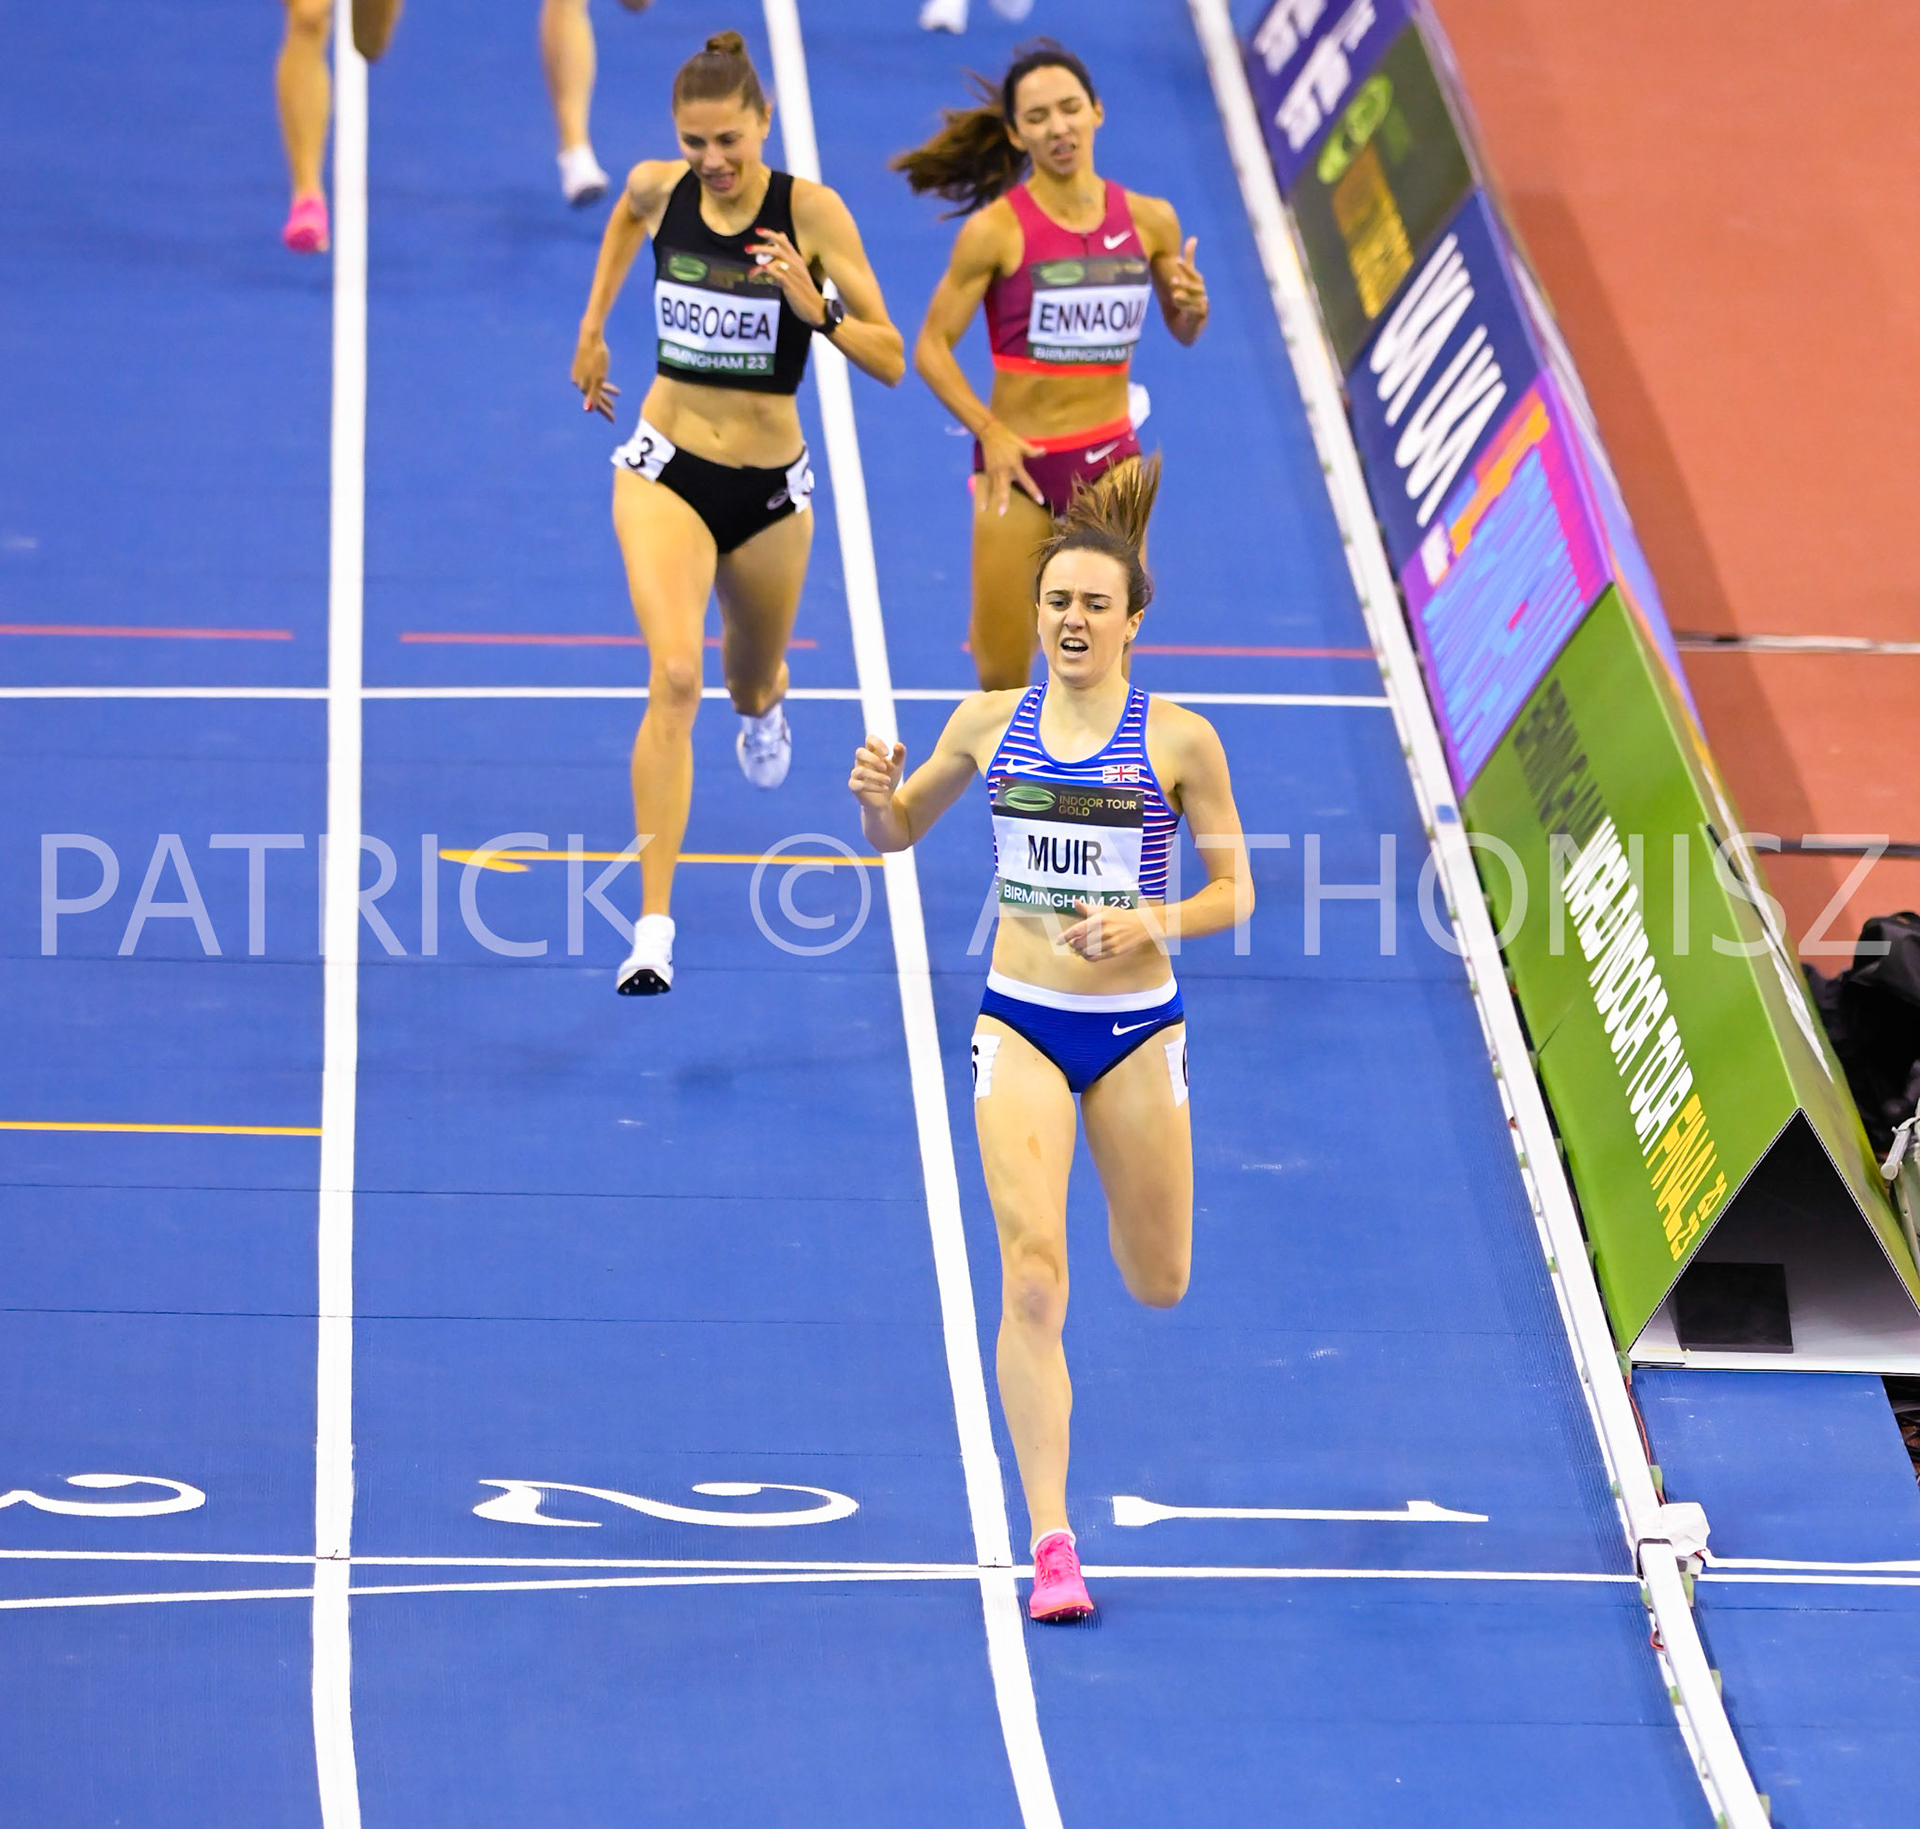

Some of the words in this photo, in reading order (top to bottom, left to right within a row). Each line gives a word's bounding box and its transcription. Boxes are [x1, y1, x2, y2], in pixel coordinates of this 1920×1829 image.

[661, 296, 771, 341] BOBOCEA
[661, 343, 744, 370] BIRMINGHAM
[747, 354, 767, 370] 23
[625, 436, 654, 469] 3
[1058, 805, 1091, 816] GOLD
[1059, 795, 1104, 808] INDOOR
[1106, 798, 1137, 810] TOUR
[1027, 835, 1102, 877] MUIR
[1003, 884, 1105, 909] BIRMINGHAM
[1109, 895, 1131, 909] 23
[1560, 815, 1638, 962] WORLD
[1588, 909, 1668, 1077] INDOOR
[1625, 1014, 1693, 1157] TOUR
[1644, 1092, 1717, 1241] FINAL
[472, 1479, 859, 1528] 2
[1112, 1496, 1489, 1527] 1
